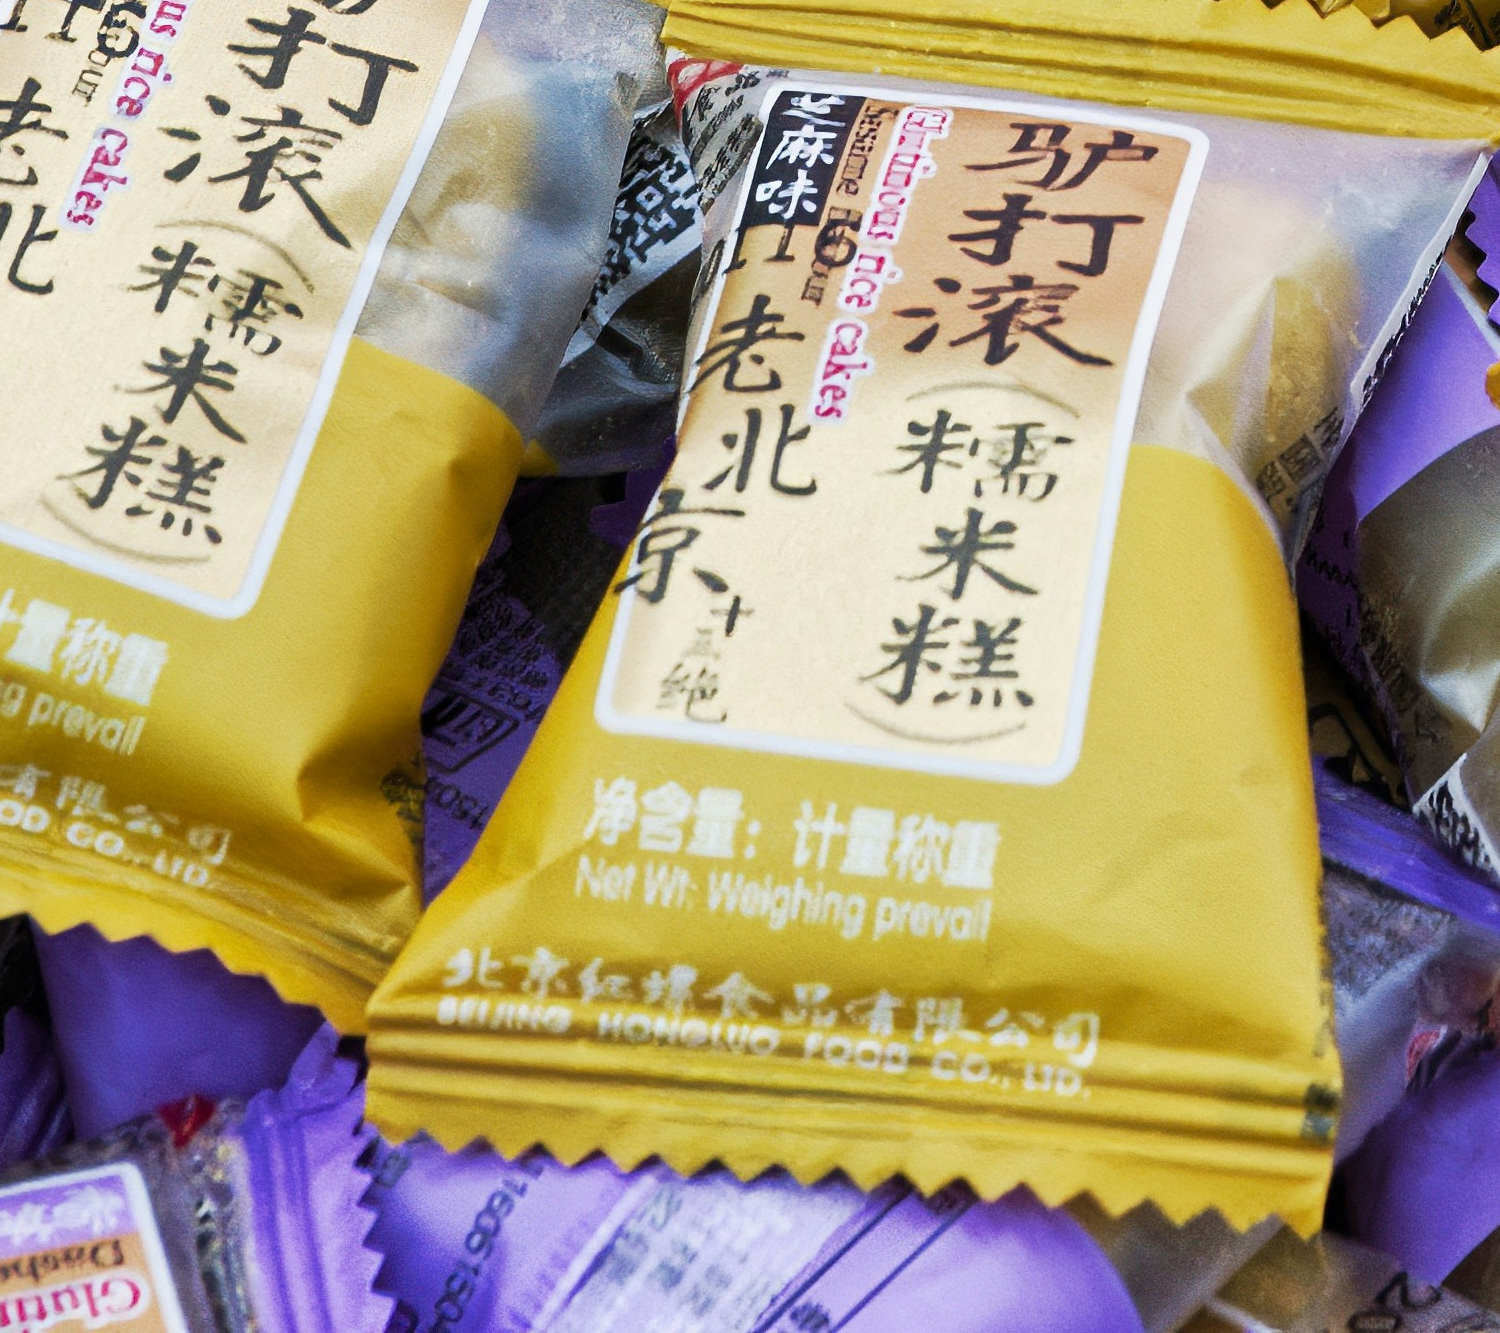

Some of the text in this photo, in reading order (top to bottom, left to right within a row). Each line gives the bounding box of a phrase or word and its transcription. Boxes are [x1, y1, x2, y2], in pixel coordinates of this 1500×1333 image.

[115, 47, 172, 117] rice
[61, 124, 132, 235] cakes
[755, 93, 848, 221] 芝麻味
[844, 254, 901, 310] rice
[892, 121, 1161, 369] 驴打滚
[815, 322, 867, 420] cakes
[612, 292, 820, 605] 老北京
[27, 686, 146, 755] prevail
[581, 774, 1002, 892] 净含量： 计量称重
[573, 854, 636, 900] Net
[706, 870, 867, 936] Weighing
[872, 893, 994, 944] prevail
[434, 995, 573, 1038] BEIJING
[595, 1008, 781, 1060] HONGLUO
[800, 1033, 909, 1077] FOOD
[441, 944, 1102, 1068] 北京红螺食品有限公司
